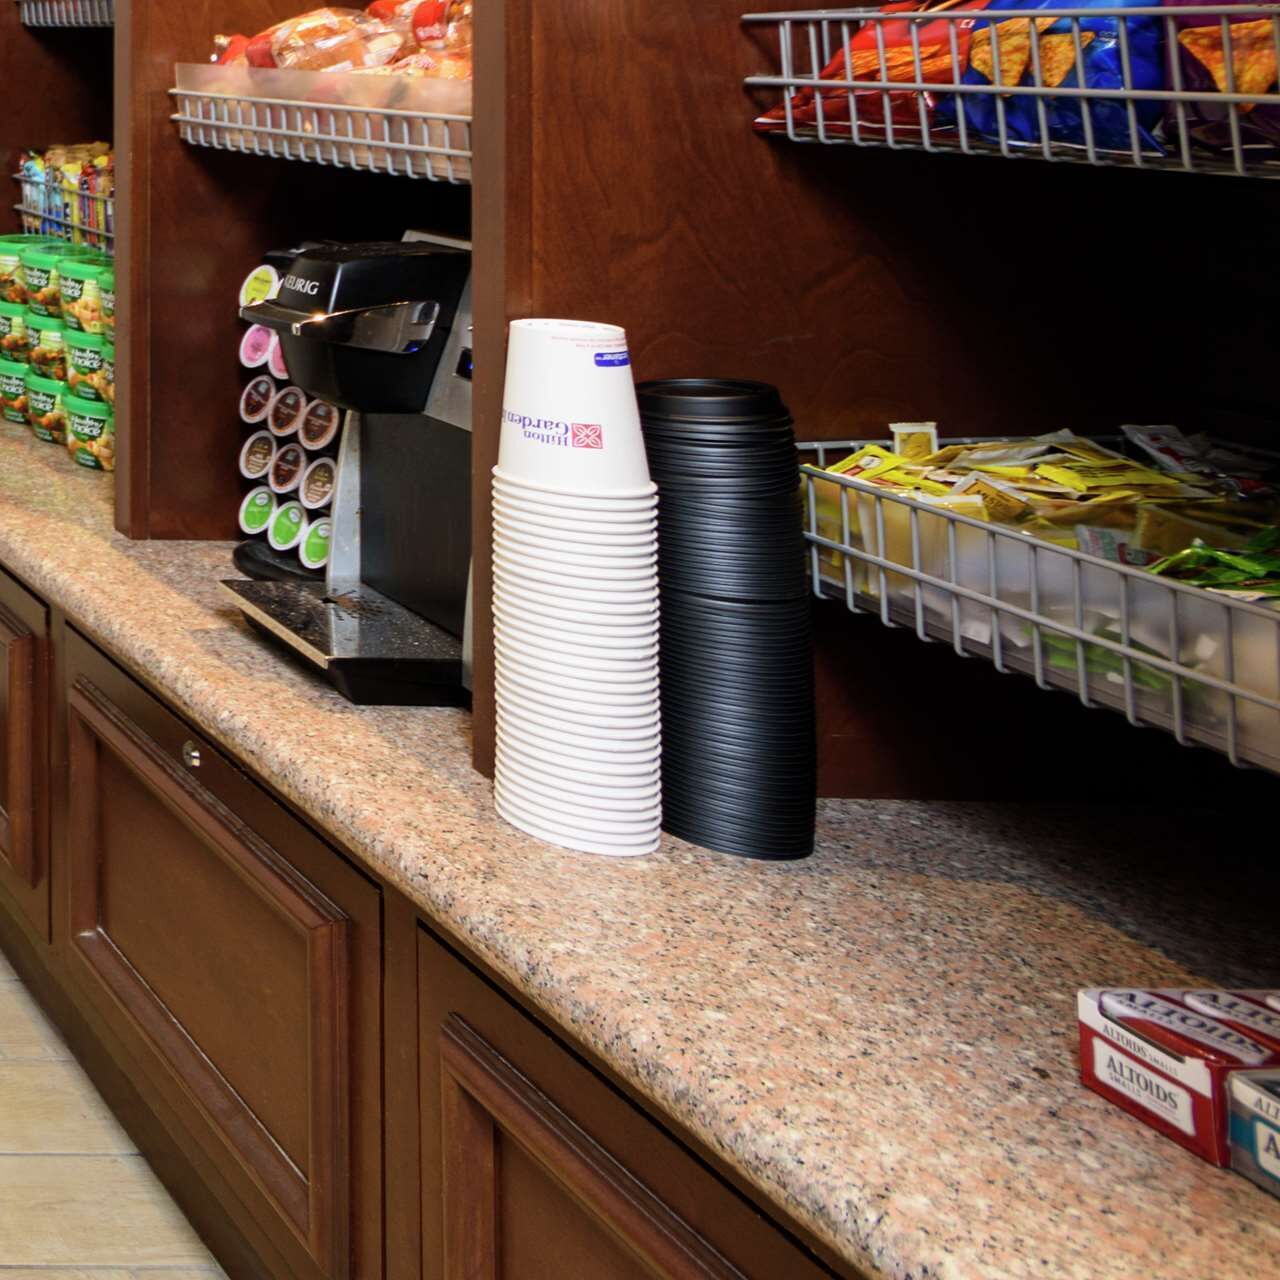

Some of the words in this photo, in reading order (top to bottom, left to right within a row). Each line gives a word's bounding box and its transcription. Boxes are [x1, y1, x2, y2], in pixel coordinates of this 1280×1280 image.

[285, 274, 320, 296] KEURIG
[506, 412, 569, 436] Garden
[523, 430, 568, 447] Hilton
[1102, 1023, 1147, 1060] ALTOIDS
[1105, 1054, 1179, 1110] ALTOIDS
